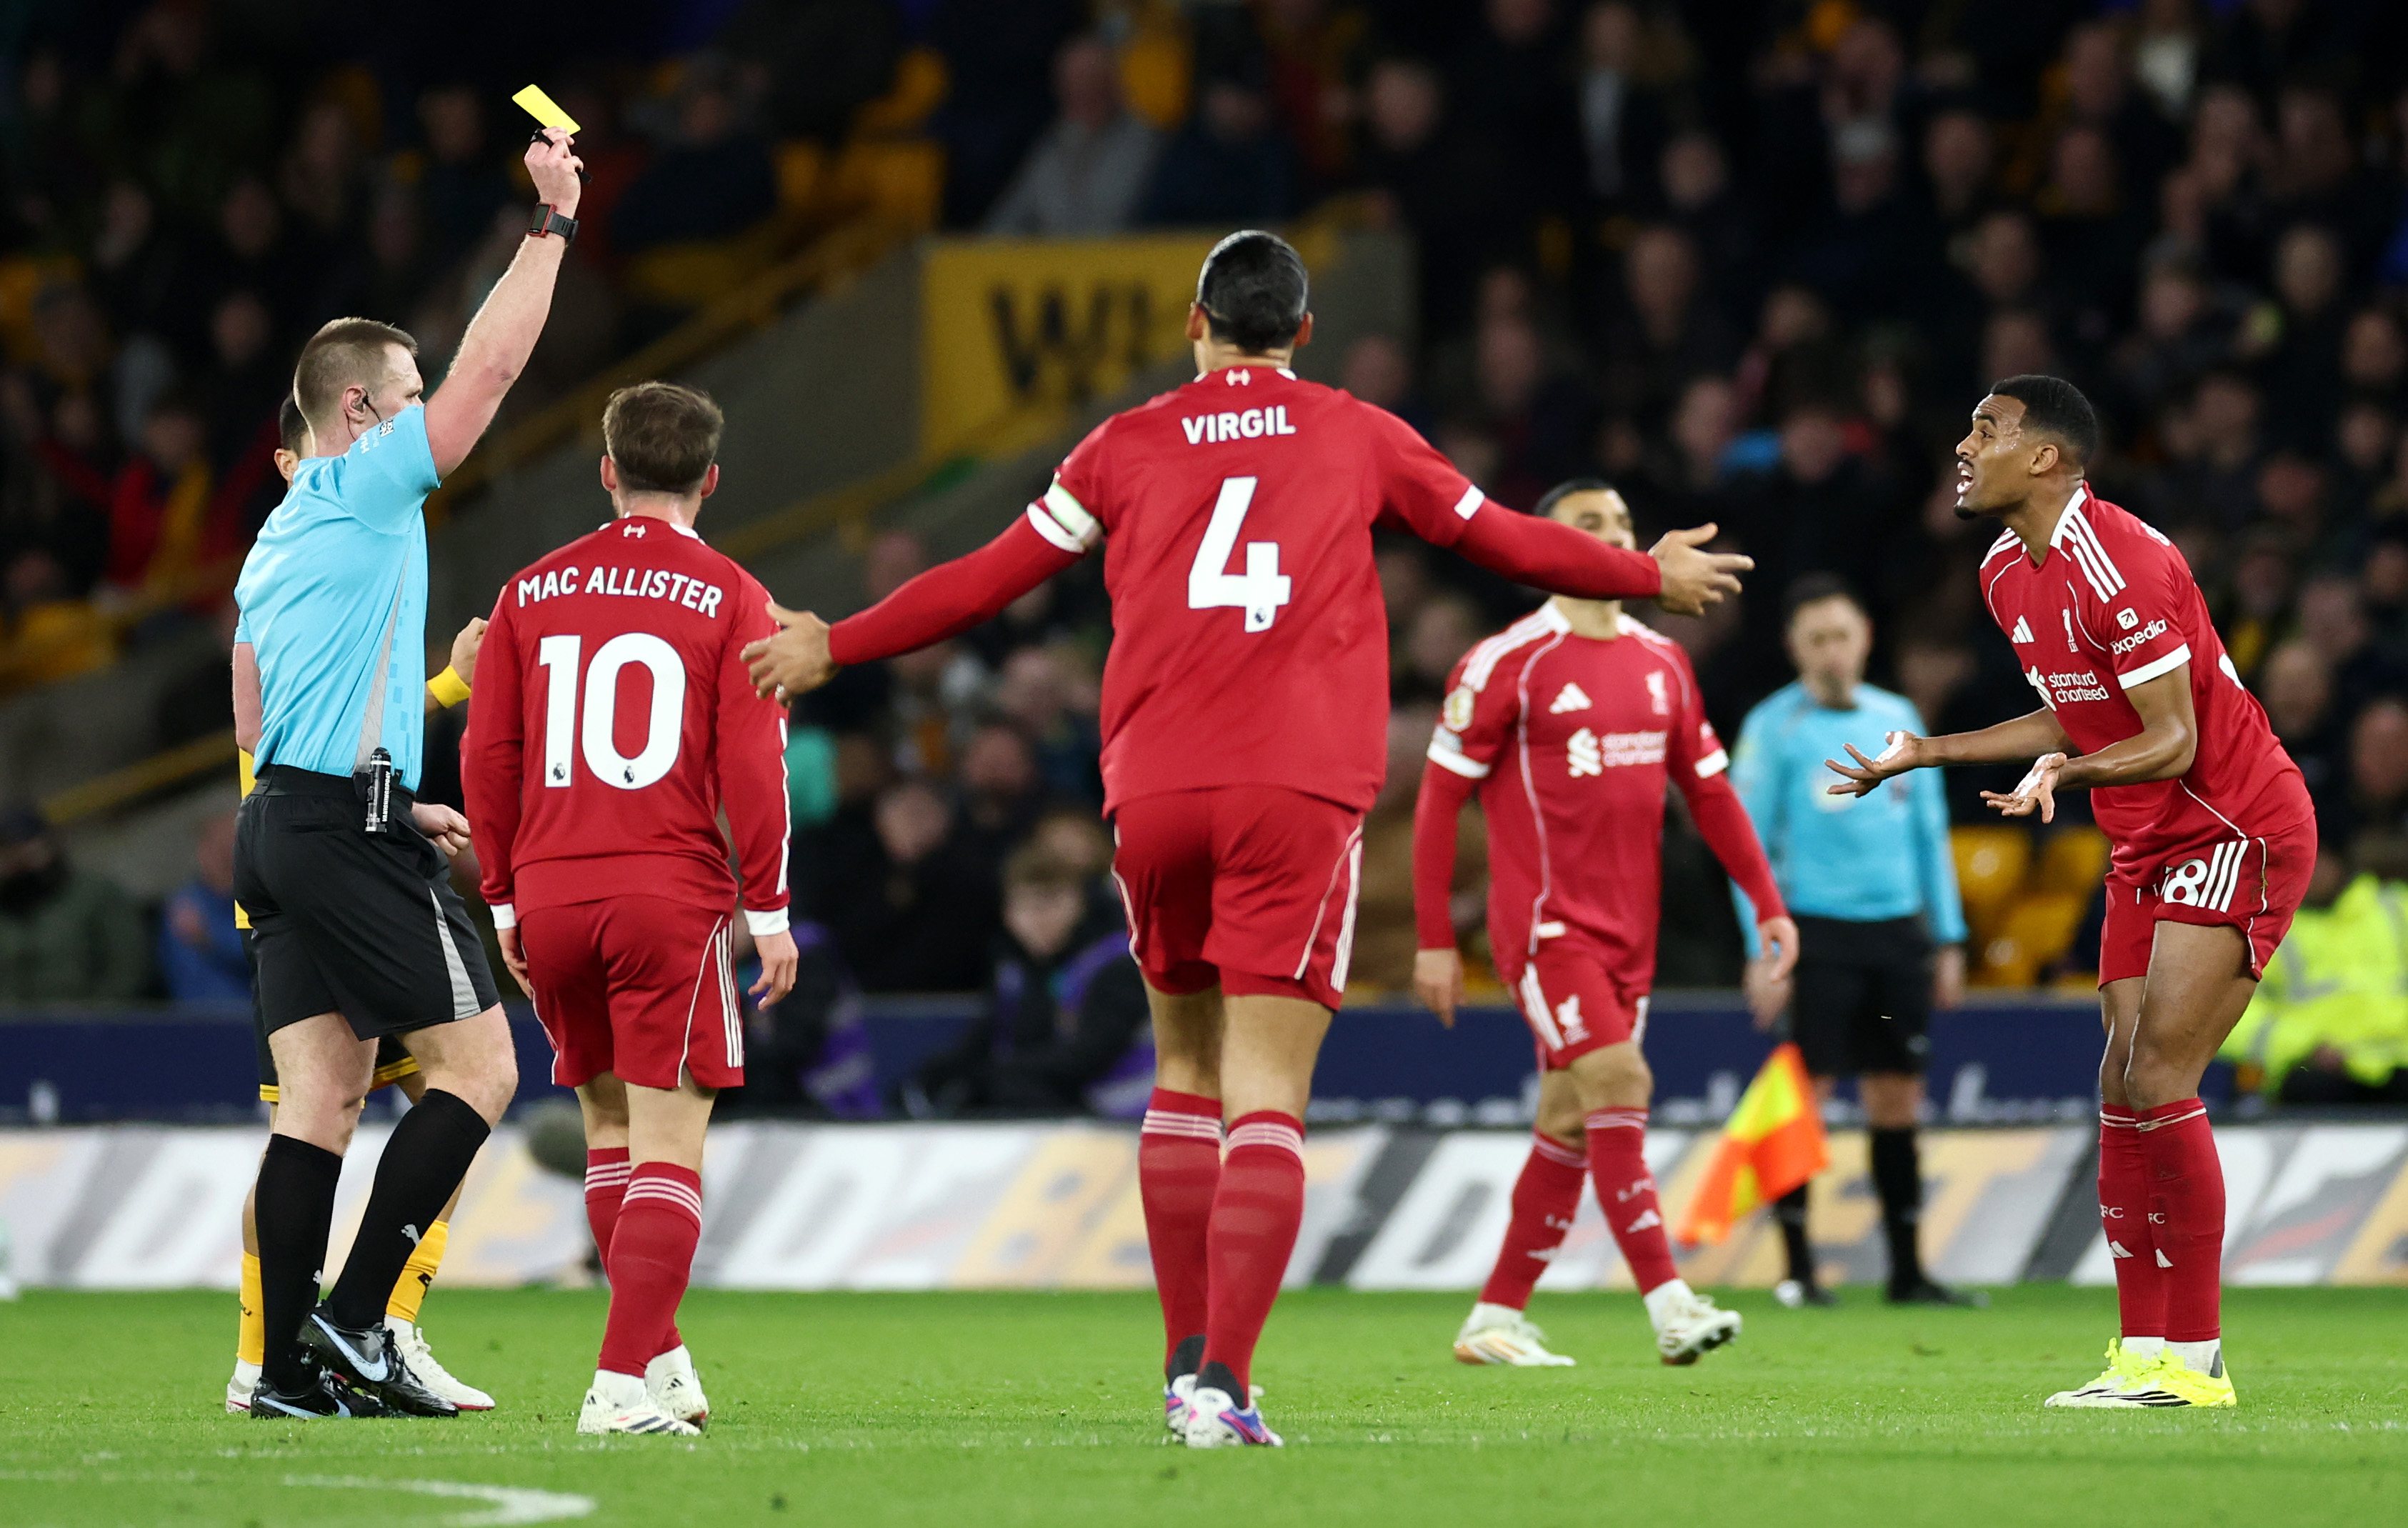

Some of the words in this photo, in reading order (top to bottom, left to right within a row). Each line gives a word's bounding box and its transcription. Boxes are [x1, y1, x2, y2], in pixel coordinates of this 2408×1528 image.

[1181, 405, 1296, 444] VIRGIL
[1188, 476, 1291, 633] 4
[518, 566, 578, 607] MAC
[585, 566, 723, 618] ALLISTER
[2109, 619, 2168, 655] Expedia
[2049, 670, 2097, 688] standard
[2056, 685, 2109, 703] chartered
[539, 633, 686, 789] 10
[2160, 859, 2208, 906] 8
